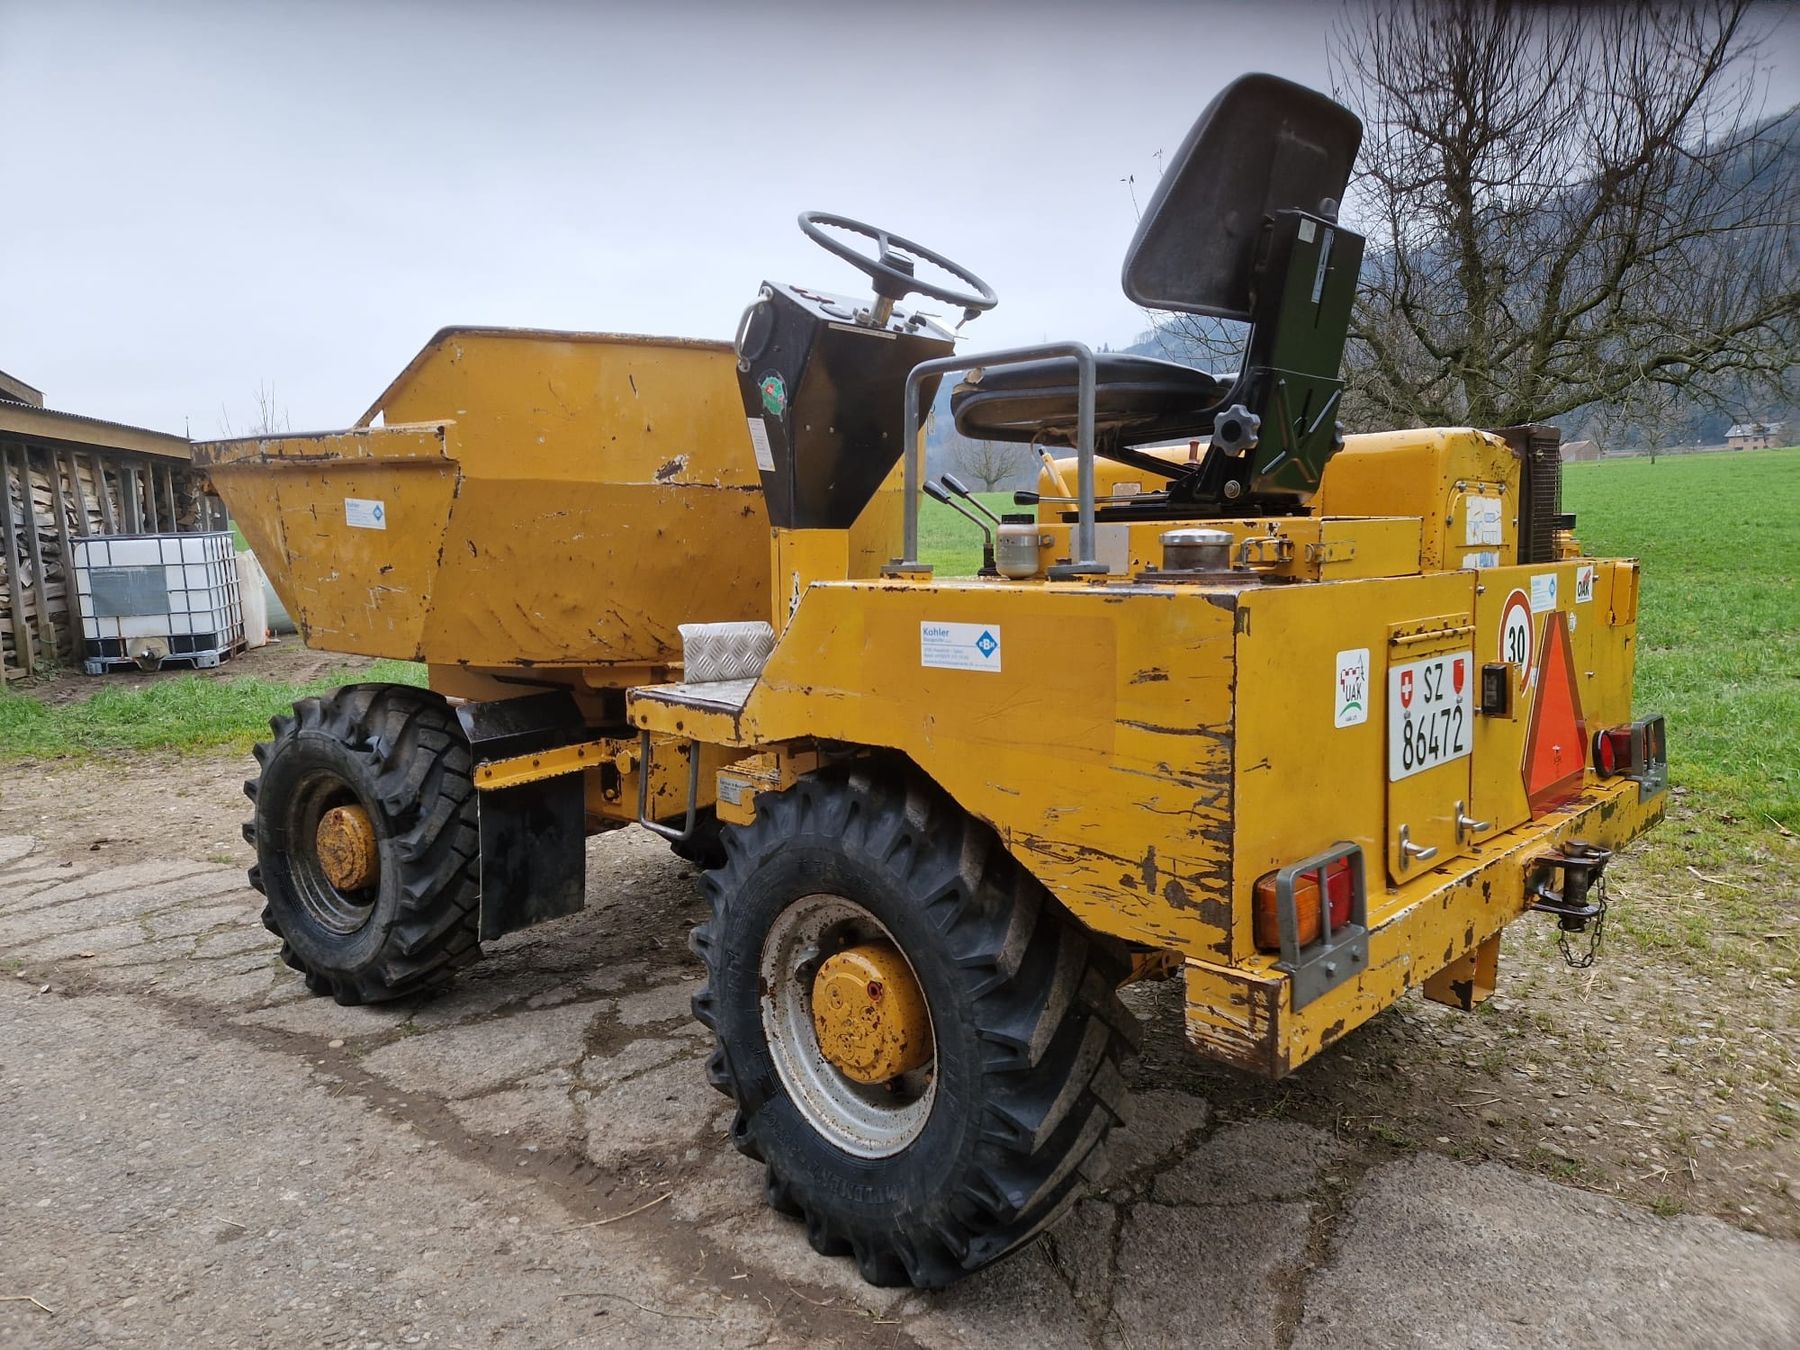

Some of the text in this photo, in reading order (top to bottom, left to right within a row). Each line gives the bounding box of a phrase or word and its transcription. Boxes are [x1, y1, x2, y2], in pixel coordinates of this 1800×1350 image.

[924, 627, 949, 637] Kohler
[1508, 624, 1526, 663] 30
[1345, 682, 1362, 702] UAK
[1424, 663, 1443, 704] SZ
[1402, 704, 1464, 771] 86472
